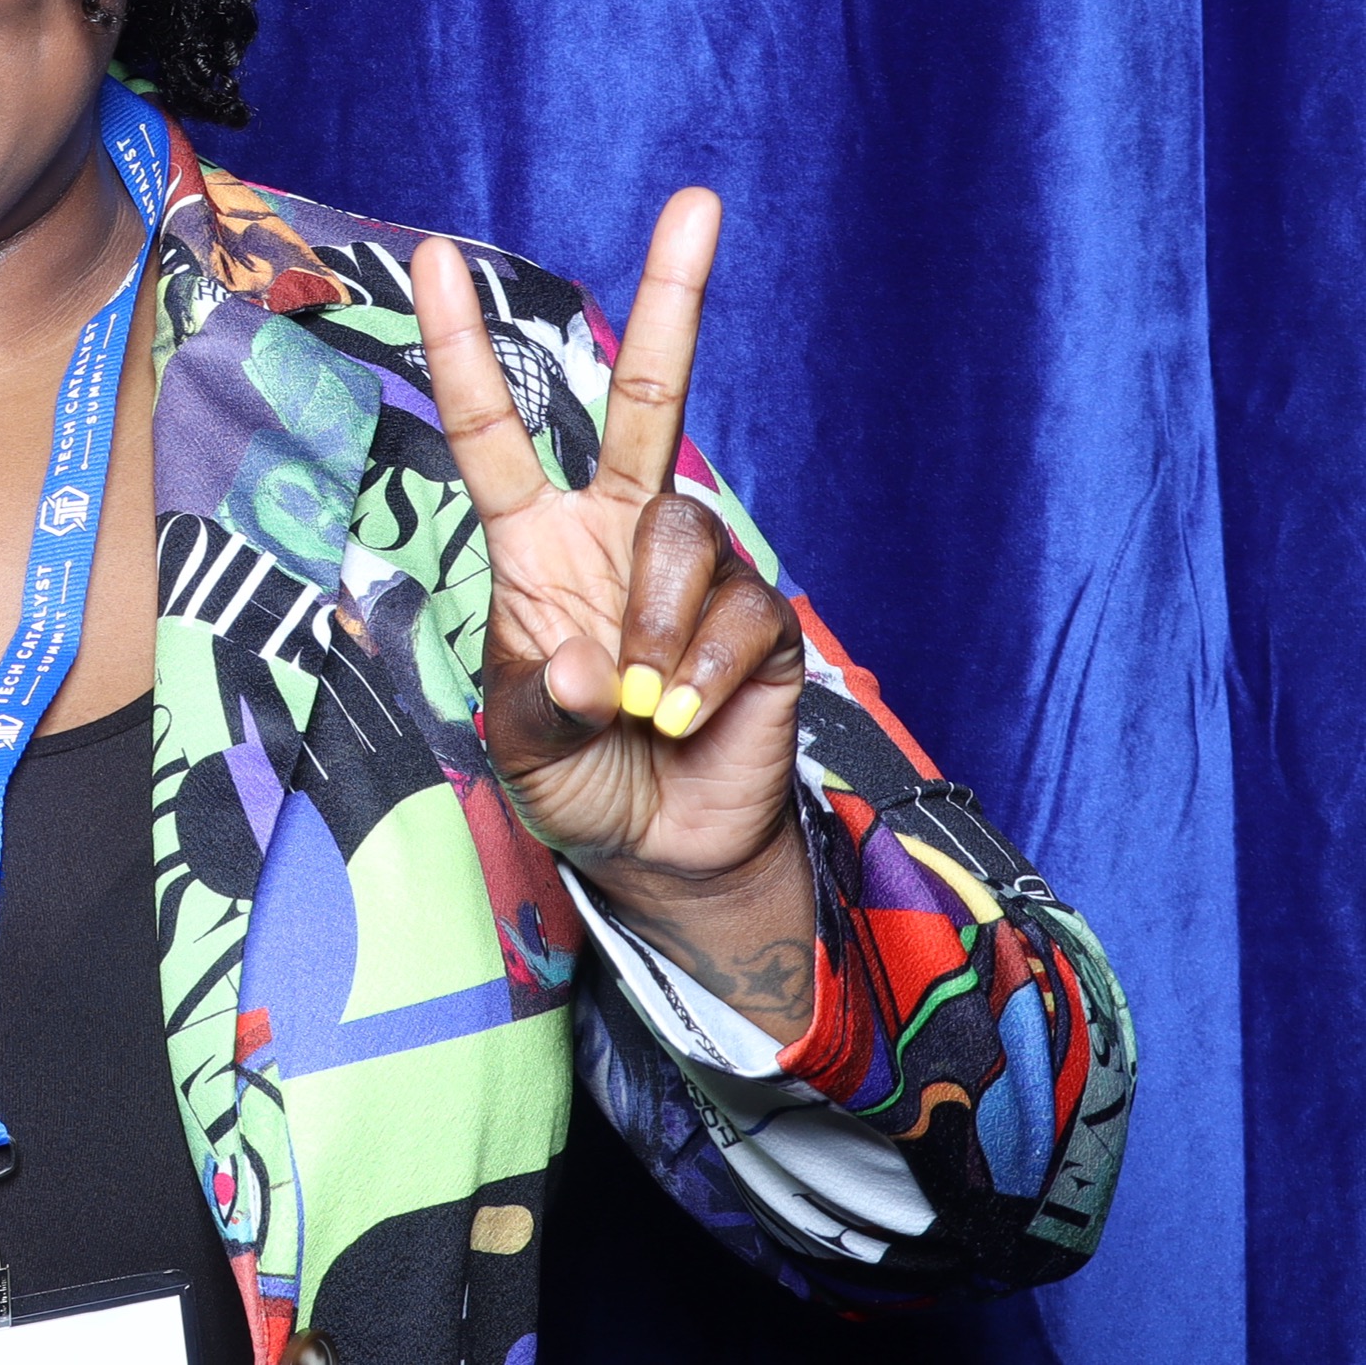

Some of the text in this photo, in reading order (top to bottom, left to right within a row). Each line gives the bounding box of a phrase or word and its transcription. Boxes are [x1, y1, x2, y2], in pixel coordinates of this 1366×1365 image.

[116, 138, 156, 226] CATALYST
[54, 322, 100, 476] TECH CATALYST
[86, 353, 107, 425] SUMMIT
[16, 565, 53, 660] CATALYST
[37, 611, 68, 672] SUMMIT
